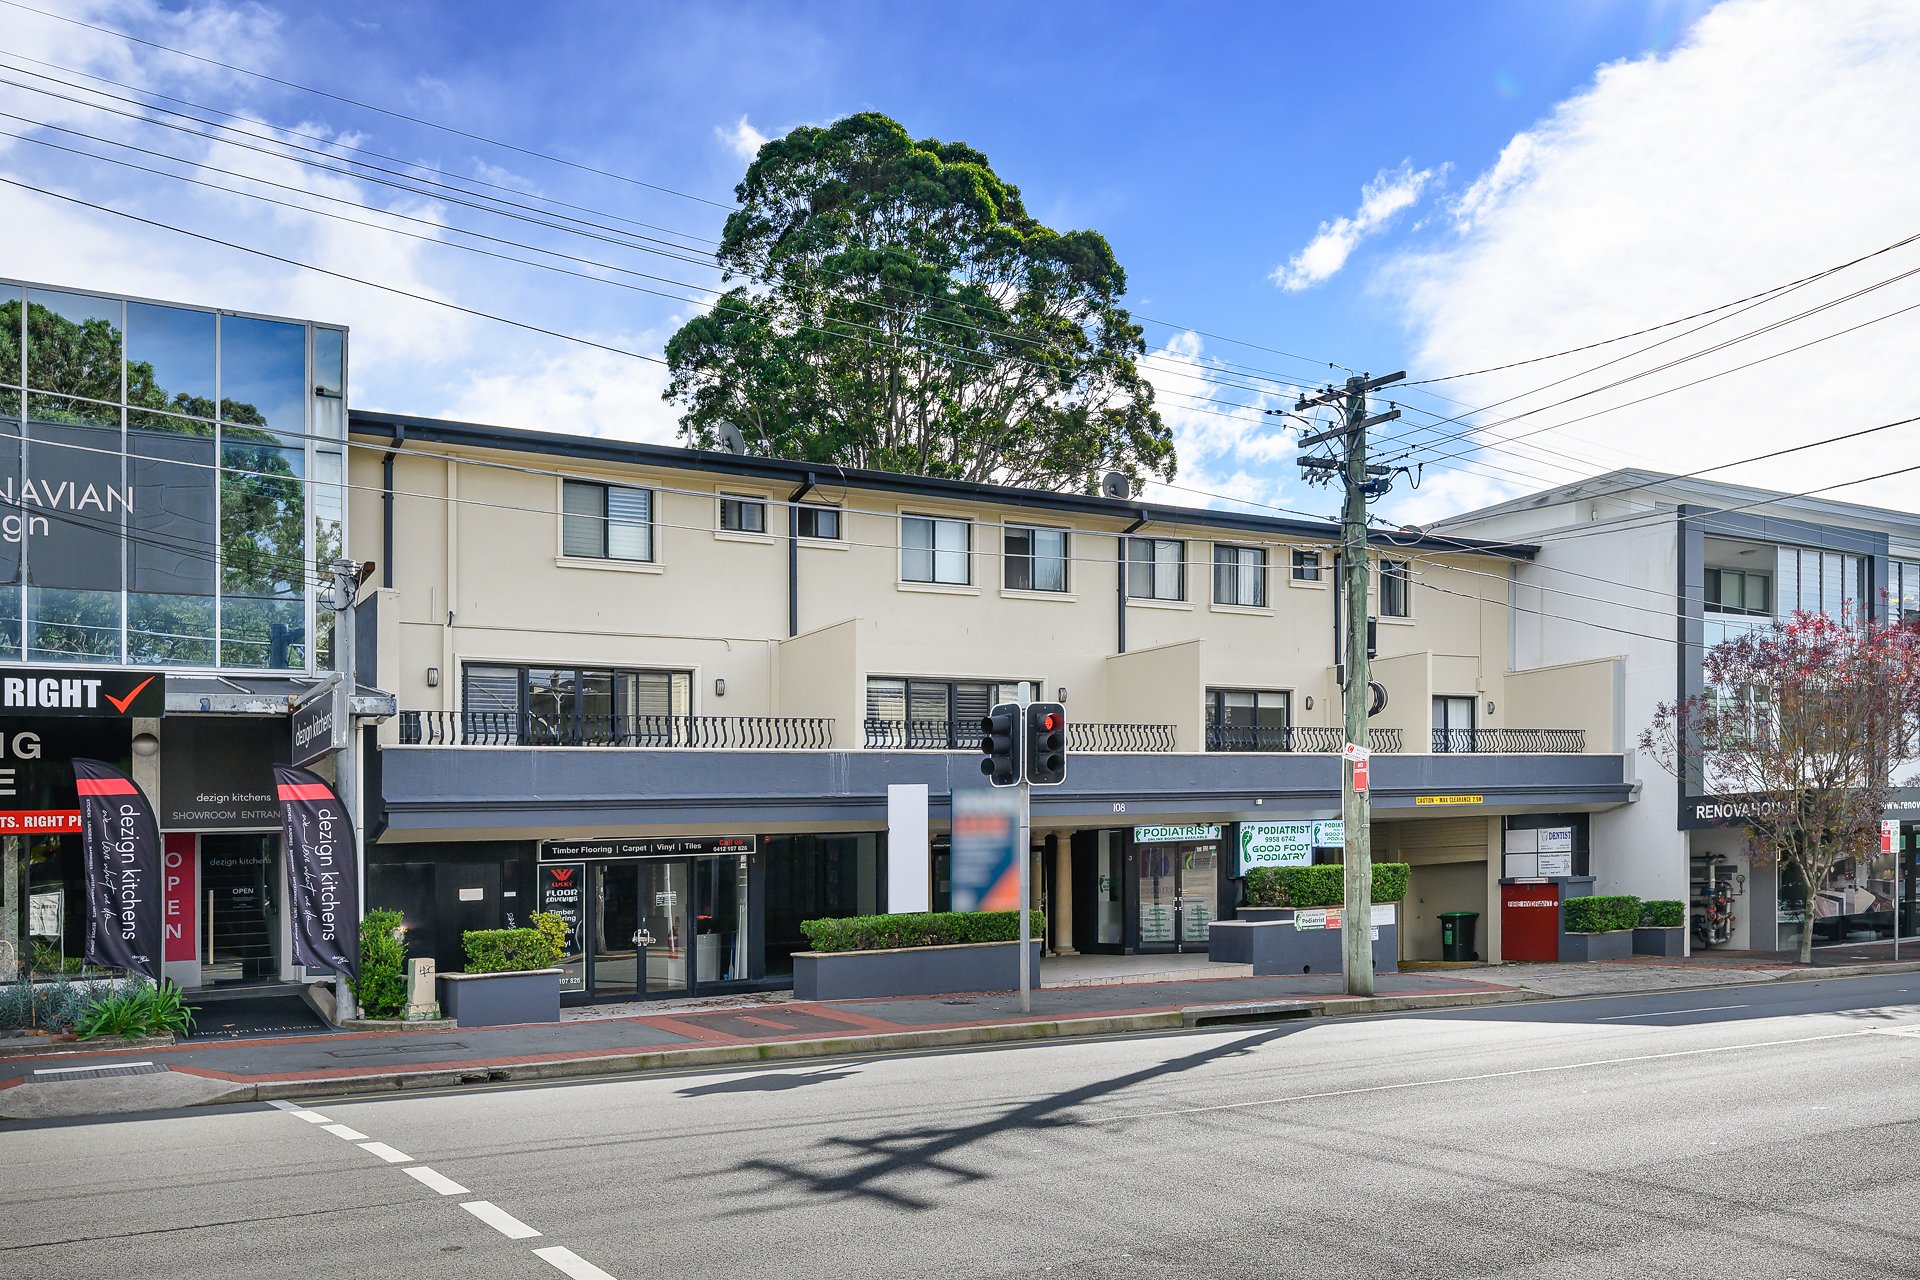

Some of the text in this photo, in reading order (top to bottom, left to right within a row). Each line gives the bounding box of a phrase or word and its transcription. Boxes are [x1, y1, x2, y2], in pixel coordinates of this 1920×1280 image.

[3, 676, 102, 708] RIGHT
[295, 710, 332, 749] dezign kitchens
[0, 731, 41, 760] G
[196, 792, 272, 804] dezign kitchens
[1113, 803, 1126, 813] 108
[24, 815, 65, 828] RIGHT
[172, 810, 237, 820] SHOWROOM
[1143, 825, 1213, 838] PODIATRIST
[1257, 825, 1311, 835] PODIATRIST
[1548, 831, 1571, 841] DENTIST
[314, 808, 338, 867] dezign
[1281, 835, 1296, 843] 6742
[101, 841, 116, 860] love
[301, 844, 315, 863] love
[580, 845, 613, 855] Flooring
[622, 844, 647, 853] Carpet
[656, 843, 675, 852] Vinyl
[684, 842, 702, 850] Tiles
[1252, 843, 1311, 853] GOOD FOOT
[209, 856, 272, 867] dezign kitchens
[1256, 852, 1307, 862] PODIATRY
[115, 804, 142, 940] dezign kitchens
[98, 863, 117, 895] what
[299, 865, 317, 897] what
[165, 852, 183, 939] OPEN
[232, 887, 254, 895] OPEN
[546, 889, 578, 897] FLOOR
[320, 871, 341, 941] kitchens
